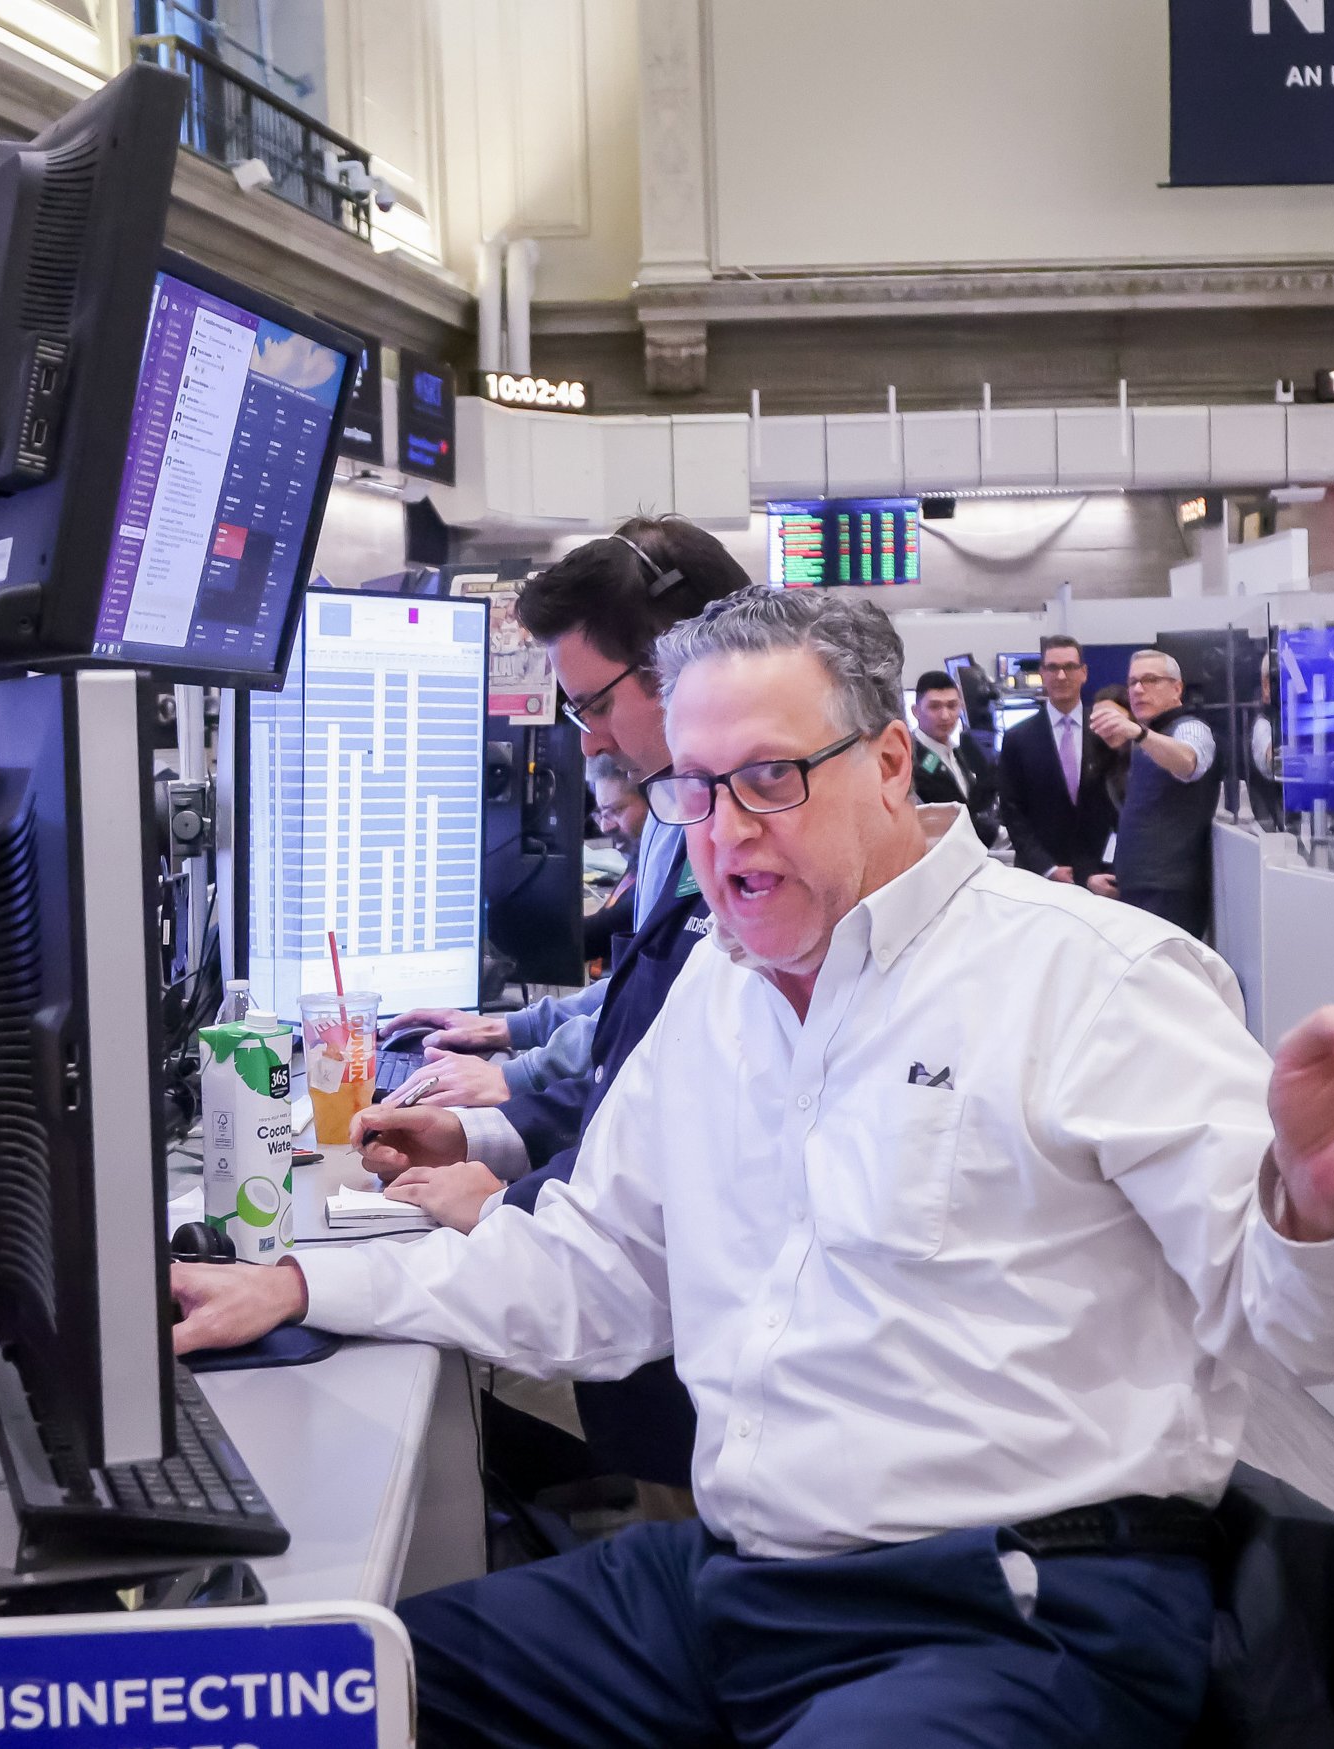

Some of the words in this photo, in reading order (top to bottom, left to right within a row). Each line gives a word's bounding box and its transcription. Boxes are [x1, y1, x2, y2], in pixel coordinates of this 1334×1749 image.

[1286, 65, 1322, 87] AN
[485, 373, 586, 408] 10:02:46
[270, 1069, 289, 1088] 365
